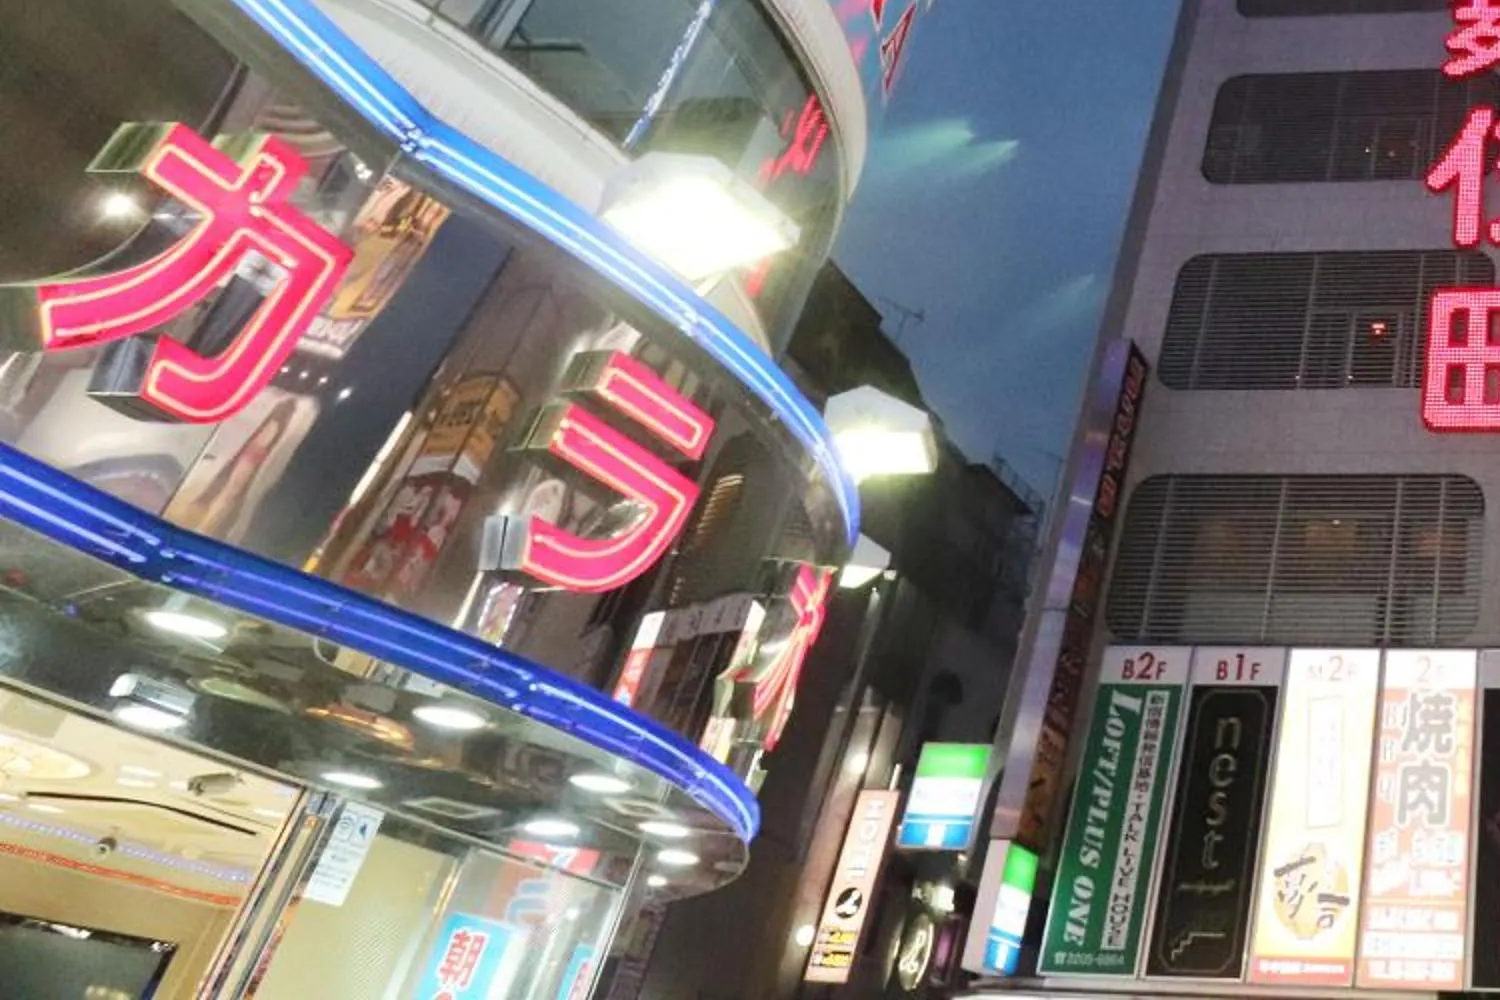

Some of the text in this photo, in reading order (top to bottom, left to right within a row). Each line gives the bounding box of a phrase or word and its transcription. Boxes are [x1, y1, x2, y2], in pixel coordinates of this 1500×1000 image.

[1121, 652, 1168, 681] B2F
[1216, 653, 1261, 681] B1F
[1398, 691, 1453, 826] 焼肉
[1063, 874, 1097, 947] ONE
